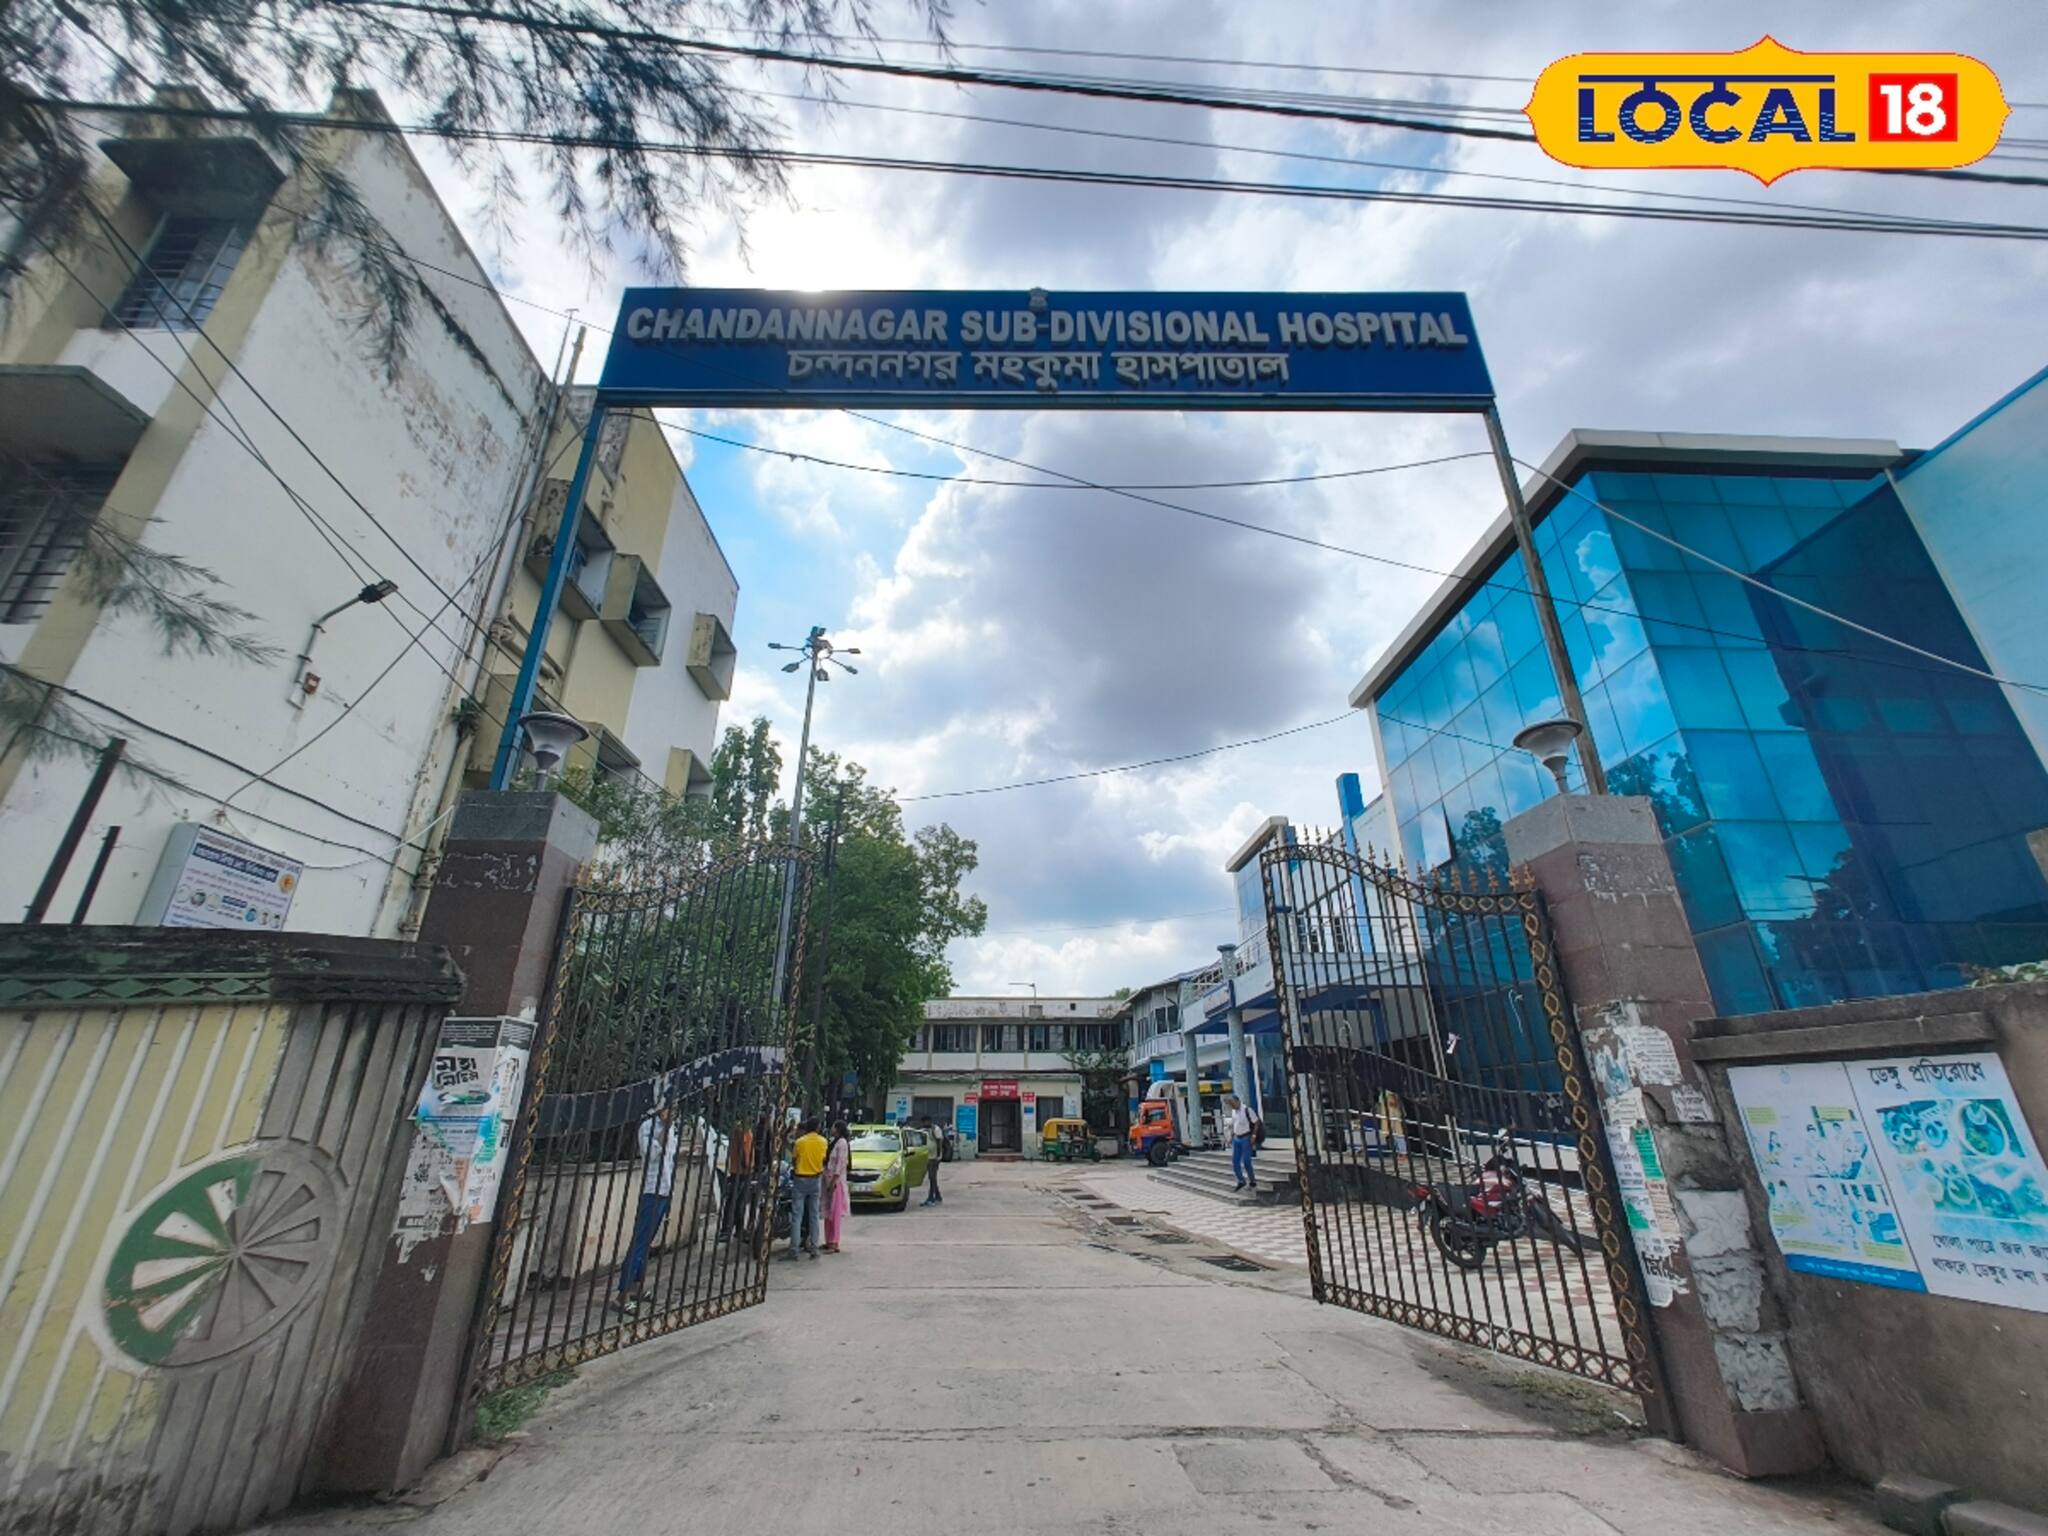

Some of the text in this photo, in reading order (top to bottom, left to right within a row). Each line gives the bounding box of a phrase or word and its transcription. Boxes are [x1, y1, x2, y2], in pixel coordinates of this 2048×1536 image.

[627, 306, 1469, 347] CHANDANNAGAR SUB-DIVISIONAL HOSPITAL
[787, 349, 1290, 392] চন্দননগর মহকুমা হাসপাতাল
[1908, 1058, 1986, 1083] প্রতিরোধে
